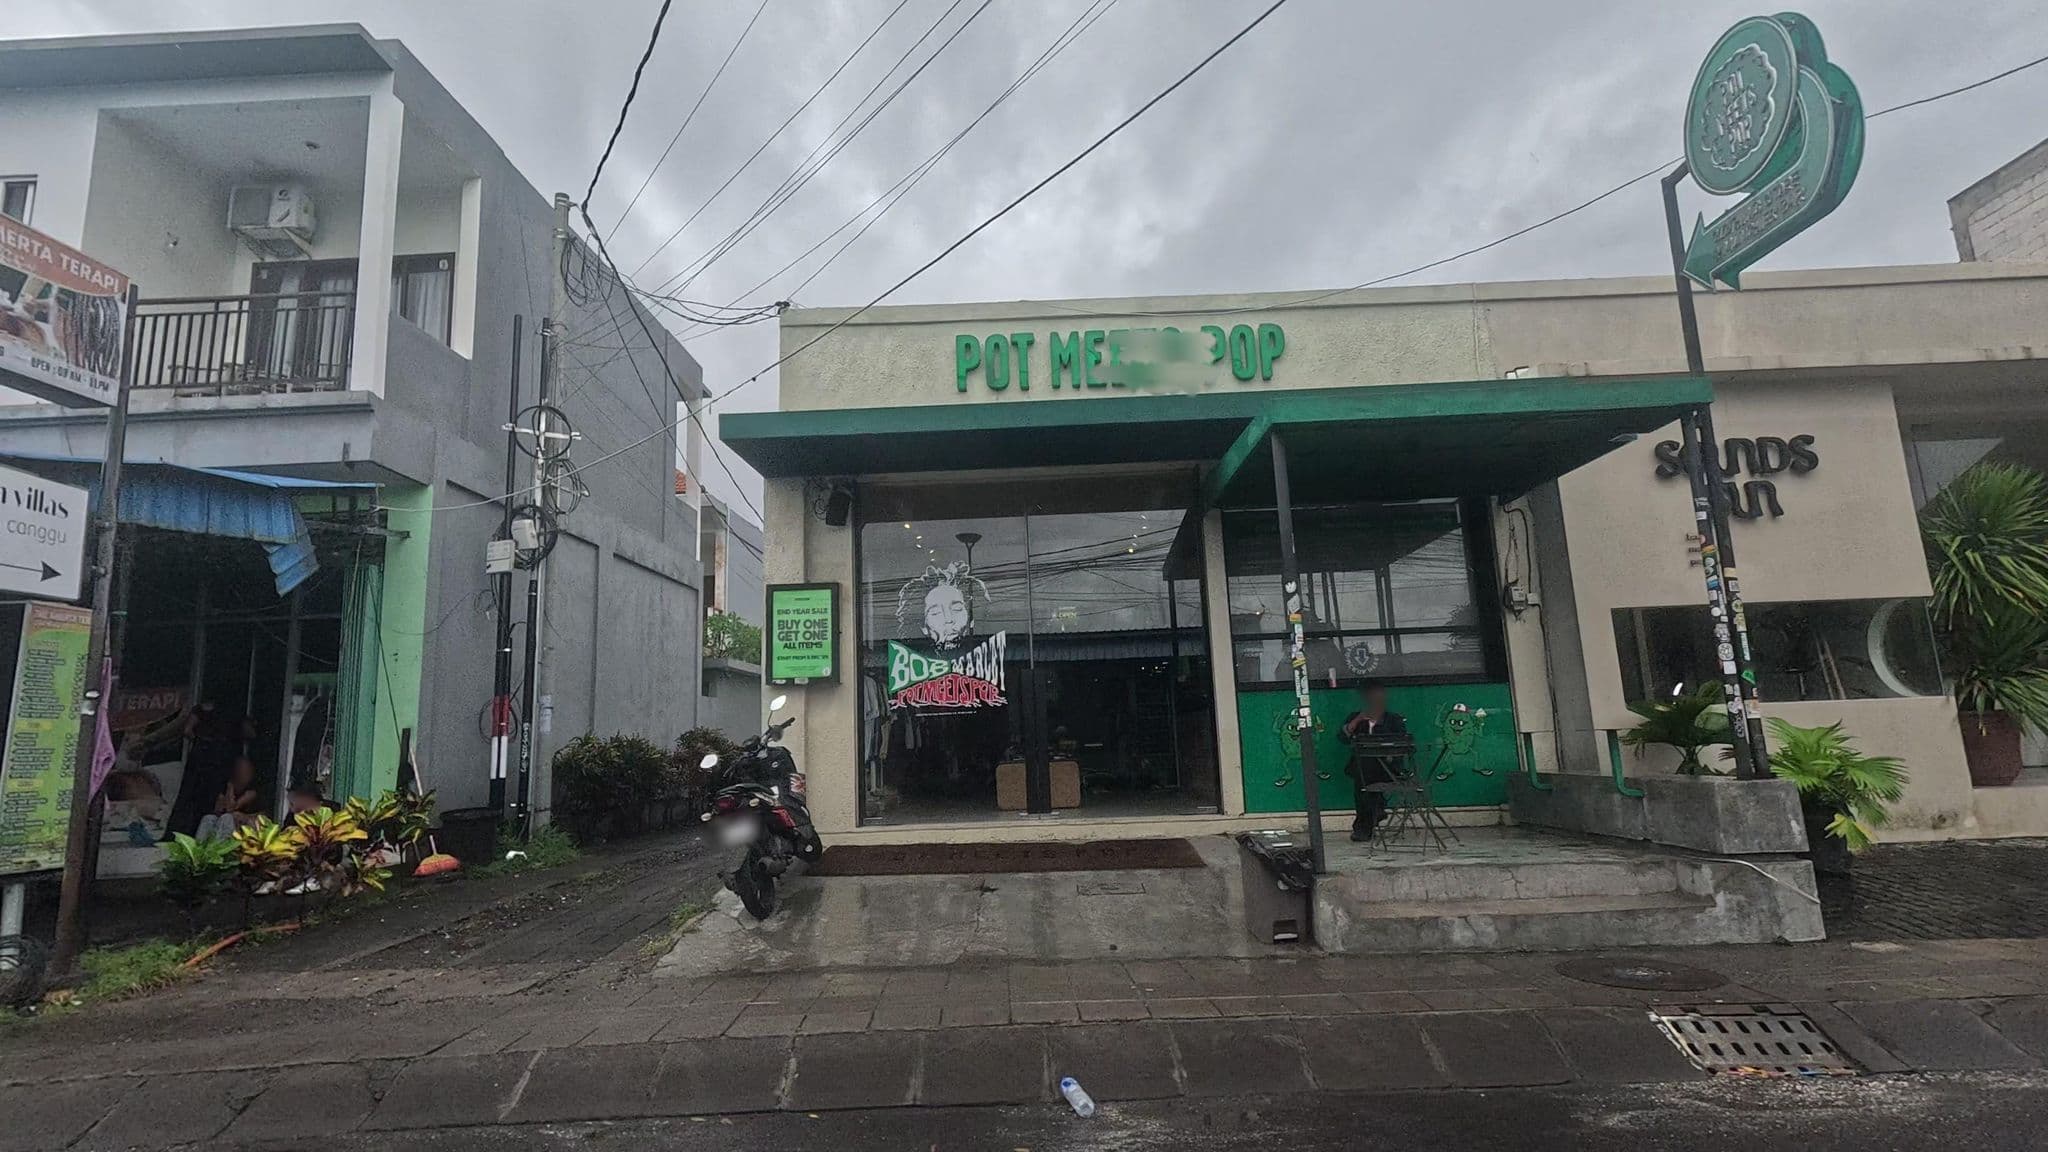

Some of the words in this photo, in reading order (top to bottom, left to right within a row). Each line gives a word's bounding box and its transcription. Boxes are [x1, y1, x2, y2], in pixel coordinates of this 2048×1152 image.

[59, 252, 119, 293] TERAPI
[955, 333, 1035, 393] POT
[14, 487, 69, 519] villas
[7, 520, 66, 545] canggu
[811, 607, 828, 615] SALE
[777, 619, 800, 630] BUY
[803, 618, 828, 629] ONE
[777, 631, 800, 641] GET
[802, 630, 828, 640] ONE
[783, 642, 797, 650] ALL
[798, 641, 822, 649] ITEMS
[889, 643, 949, 691] BOB
[951, 630, 1007, 691] MARLEY
